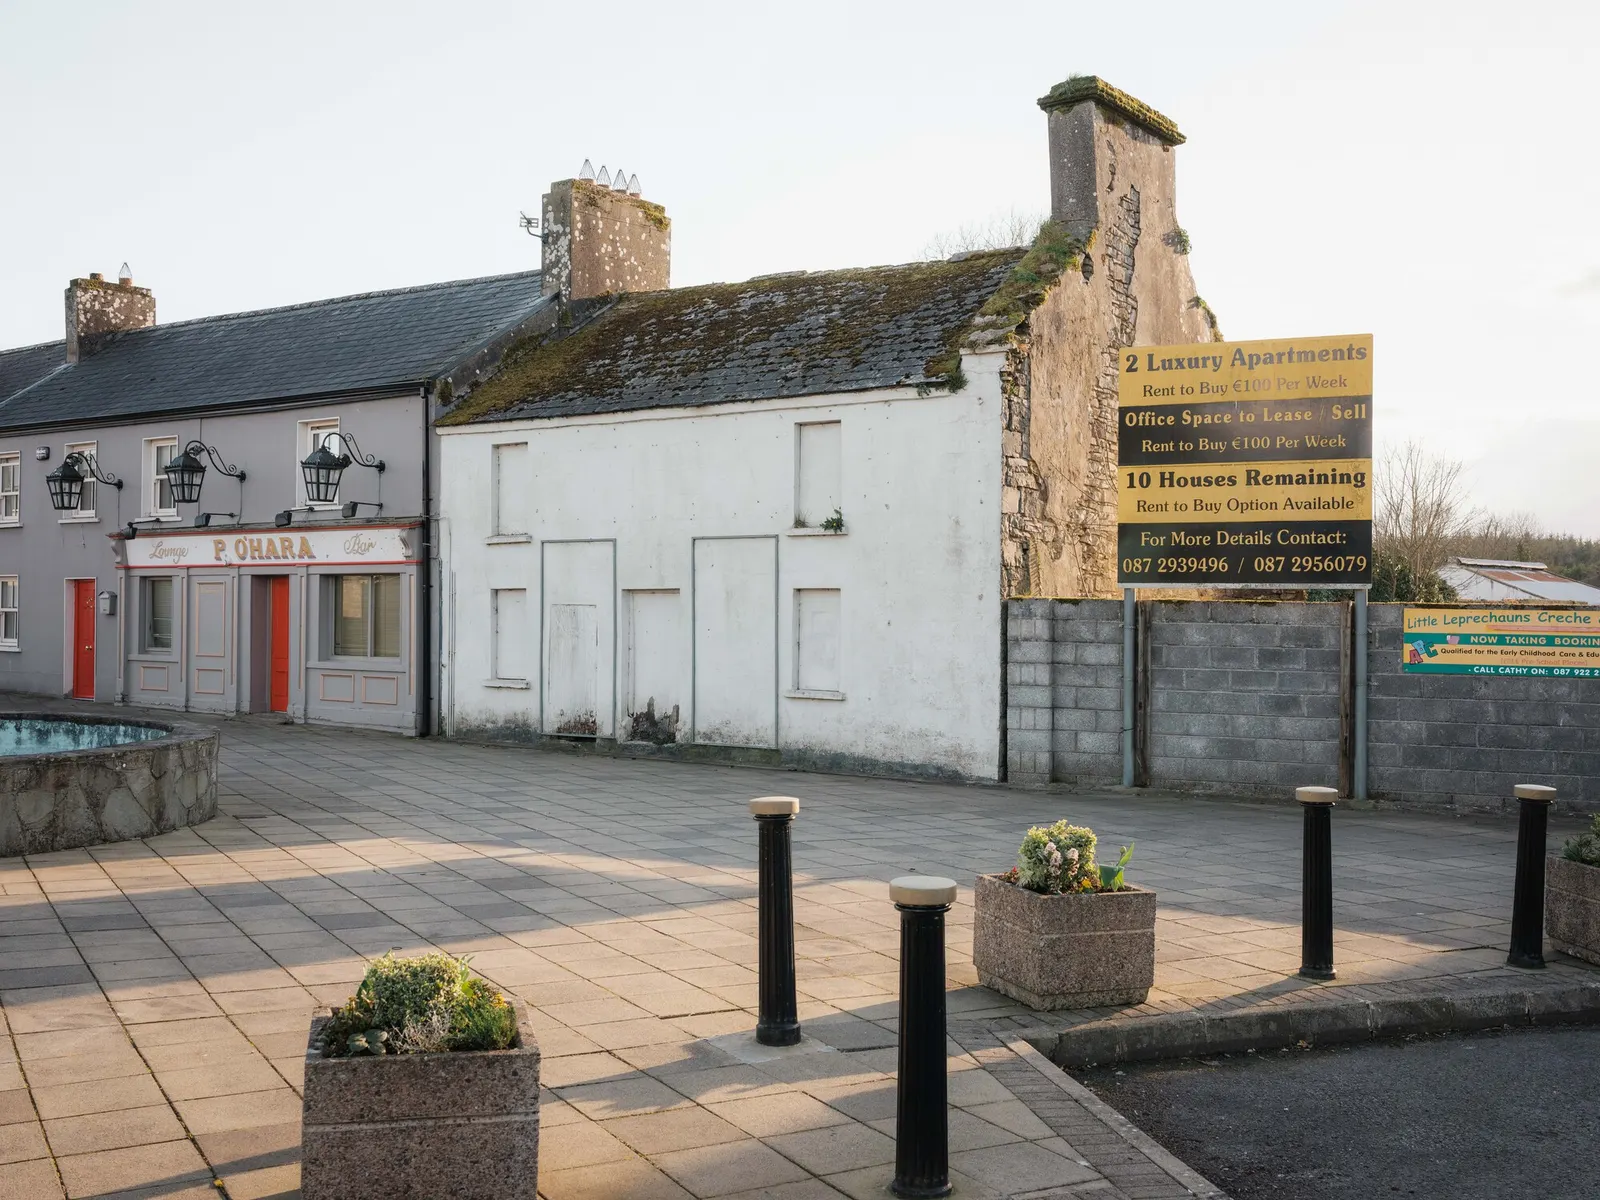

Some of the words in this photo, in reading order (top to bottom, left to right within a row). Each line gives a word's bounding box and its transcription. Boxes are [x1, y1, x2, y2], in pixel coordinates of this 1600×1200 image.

[1125, 353, 1139, 373] 2
[1147, 353, 1223, 373] Luxury
[1230, 343, 1367, 371] Apartments
[1142, 384, 1176, 397] Rent
[1180, 384, 1195, 396] to
[1199, 381, 1228, 397] Buy
[1232, 378, 1272, 393] €100
[1276, 377, 1300, 391] Per
[1305, 374, 1348, 390] Week
[1125, 409, 1175, 427] Office
[1181, 408, 1232, 428] Space
[1239, 409, 1256, 423] to
[1263, 407, 1313, 422] Lease
[1331, 403, 1367, 420] Sell
[1142, 439, 1175, 452] Rent
[1179, 440, 1194, 452] to
[1199, 437, 1227, 453] Buy
[1232, 436, 1271, 450] €100
[1276, 435, 1300, 449] Per
[1304, 434, 1347, 448] Week
[1126, 471, 1151, 489] 10
[1159, 471, 1238, 488] Houses
[1245, 468, 1366, 489] Remaining
[1136, 499, 1169, 513] Rent
[1173, 500, 1188, 512] to
[1193, 498, 1222, 514] Buy
[1226, 497, 1279, 514] Option
[1283, 496, 1355, 511] Available
[1140, 531, 1166, 547] For
[1170, 531, 1211, 546] More
[1216, 529, 1272, 546] Details
[1276, 529, 1347, 545] Contact:
[1122, 558, 1152, 573] 087
[1157, 557, 1229, 573] 2939496
[1237, 557, 1245, 574] /
[1254, 556, 1286, 572] 087
[1291, 555, 1367, 572] 2956079
[1408, 615, 1438, 629] Little
[1443, 611, 1530, 627] Leprechauns
[1537, 611, 1591, 624] Creche
[1470, 635, 1498, 643] NOW
[1505, 636, 1547, 645] TAKING
[1441, 647, 1473, 655] Qualified
[1500, 649, 1517, 657] Early
[1519, 649, 1556, 657] Childhood
[1559, 650, 1576, 658] Care
[1473, 666, 1496, 674] CALL
[1498, 666, 1528, 674] CATHY
[1531, 667, 1549, 675] ON:
[1553, 668, 1570, 676] 087
[1573, 668, 1591, 676] 922
